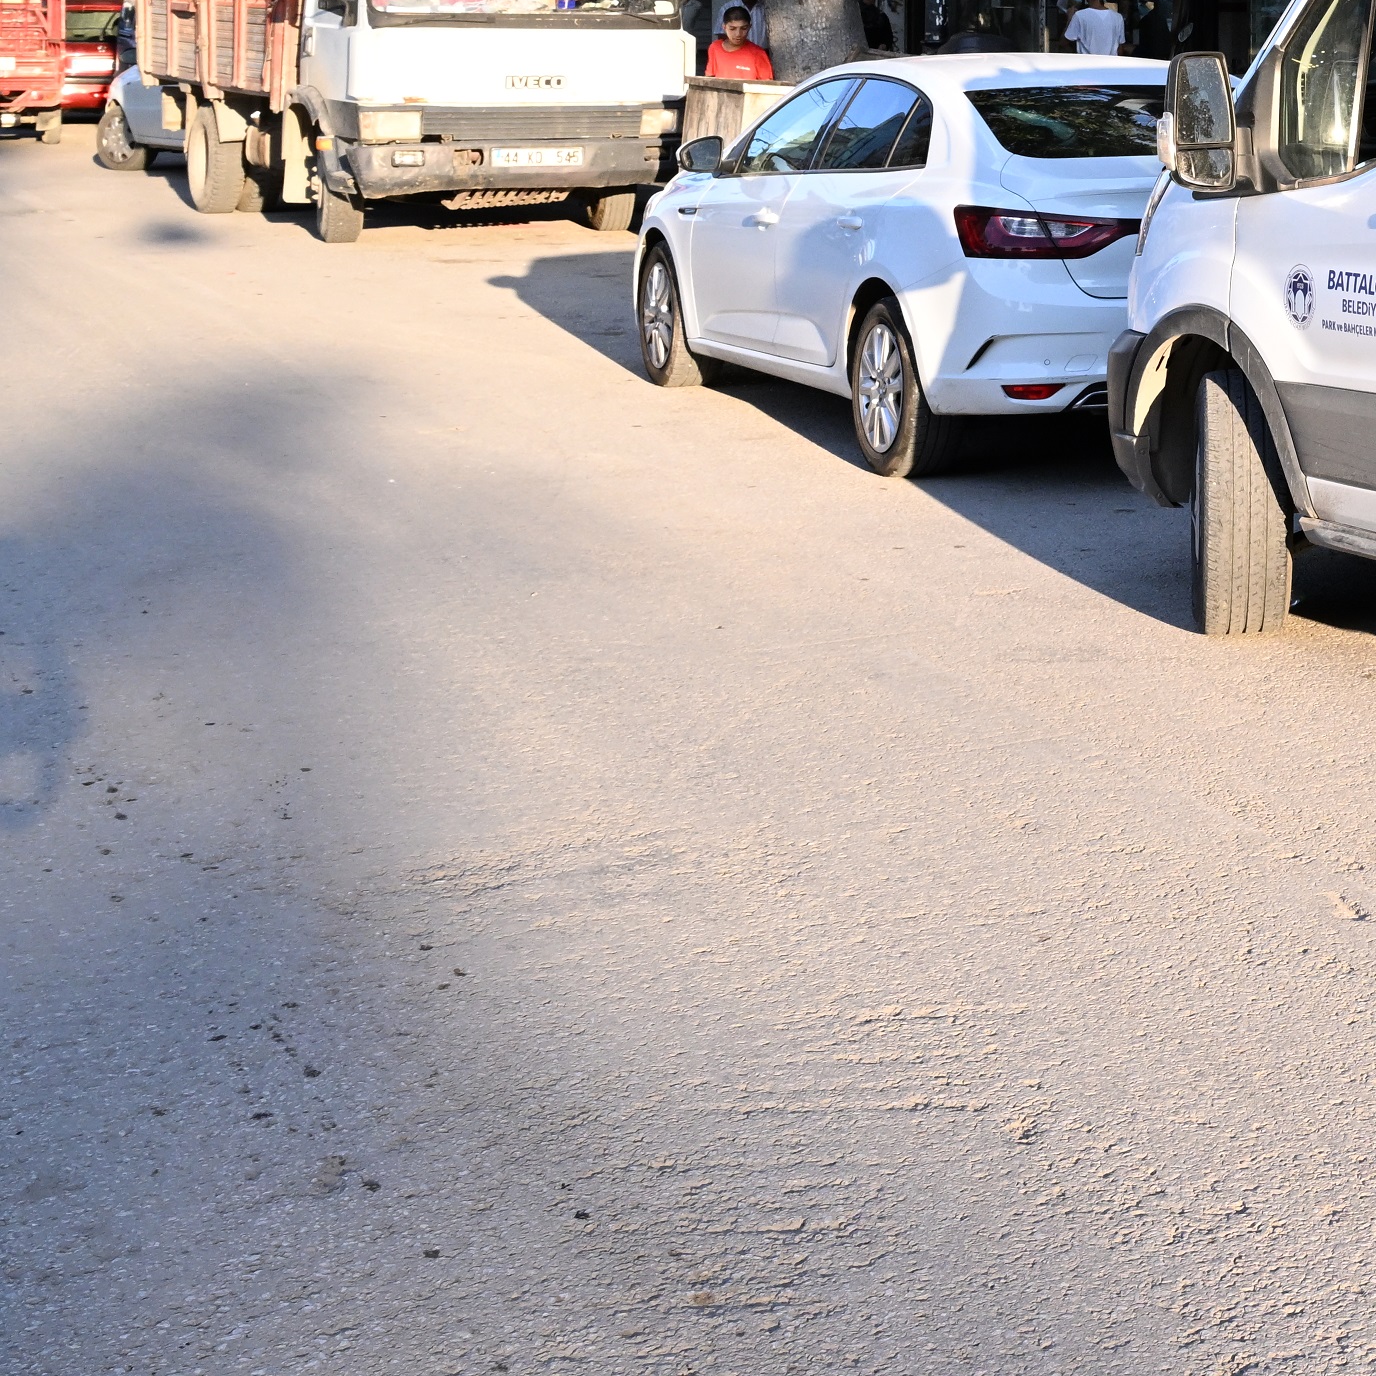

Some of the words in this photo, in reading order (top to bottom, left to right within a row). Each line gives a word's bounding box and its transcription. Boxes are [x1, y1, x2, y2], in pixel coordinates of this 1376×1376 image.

[505, 76, 567, 89] IVECO
[1322, 319, 1336, 331] PARK
[1336, 324, 1343, 332] ve
[1344, 322, 1373, 337] BAHÇELER
